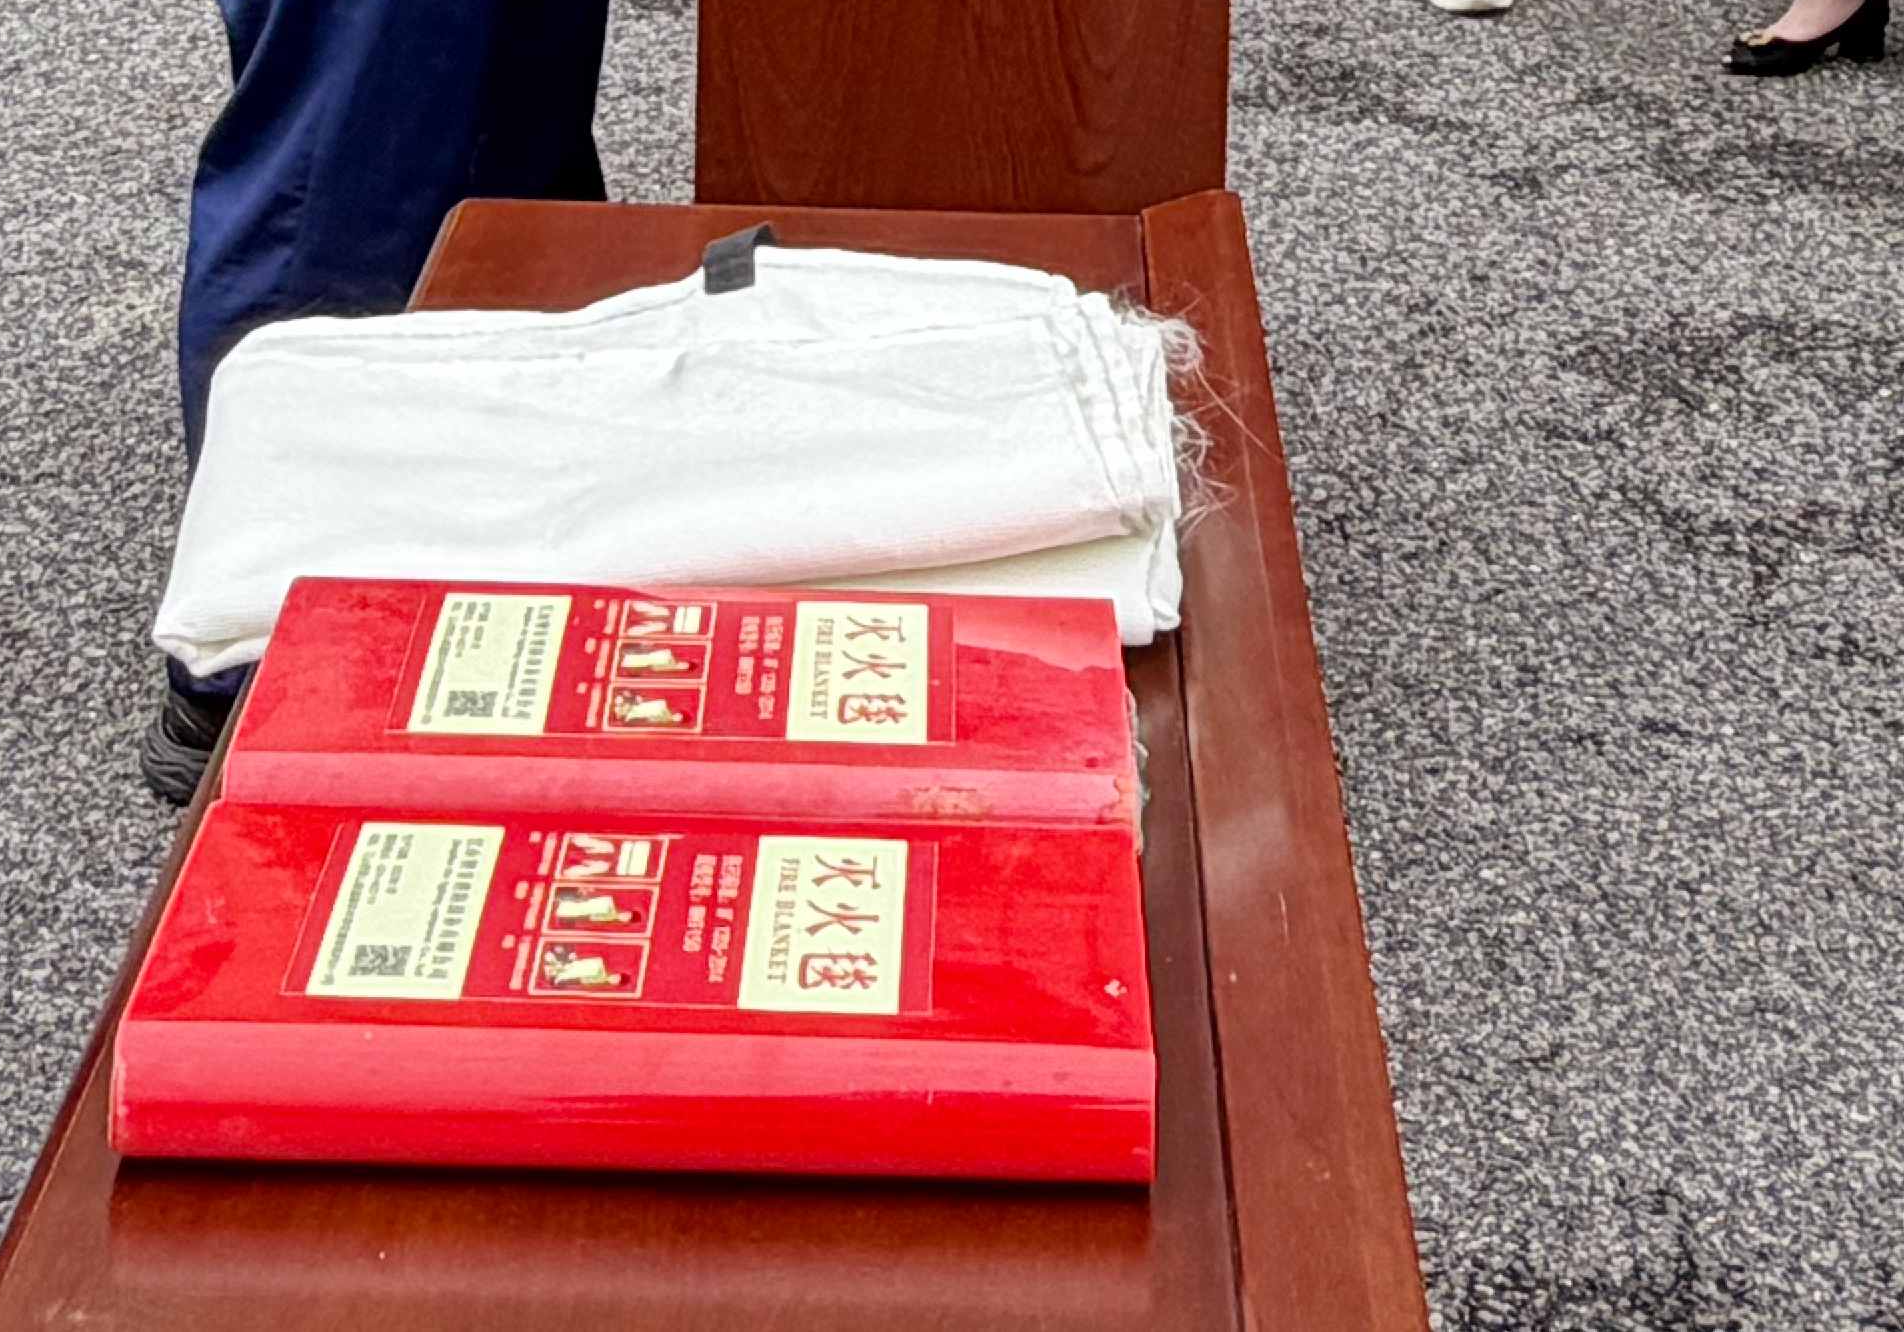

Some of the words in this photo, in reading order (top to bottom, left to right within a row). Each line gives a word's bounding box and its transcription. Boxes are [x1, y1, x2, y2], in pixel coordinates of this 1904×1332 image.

[836, 615, 909, 725] 灭火毯
[777, 857, 801, 894] FIRE
[798, 853, 882, 990] 灭火毯
[766, 899, 797, 984] BLANKET
